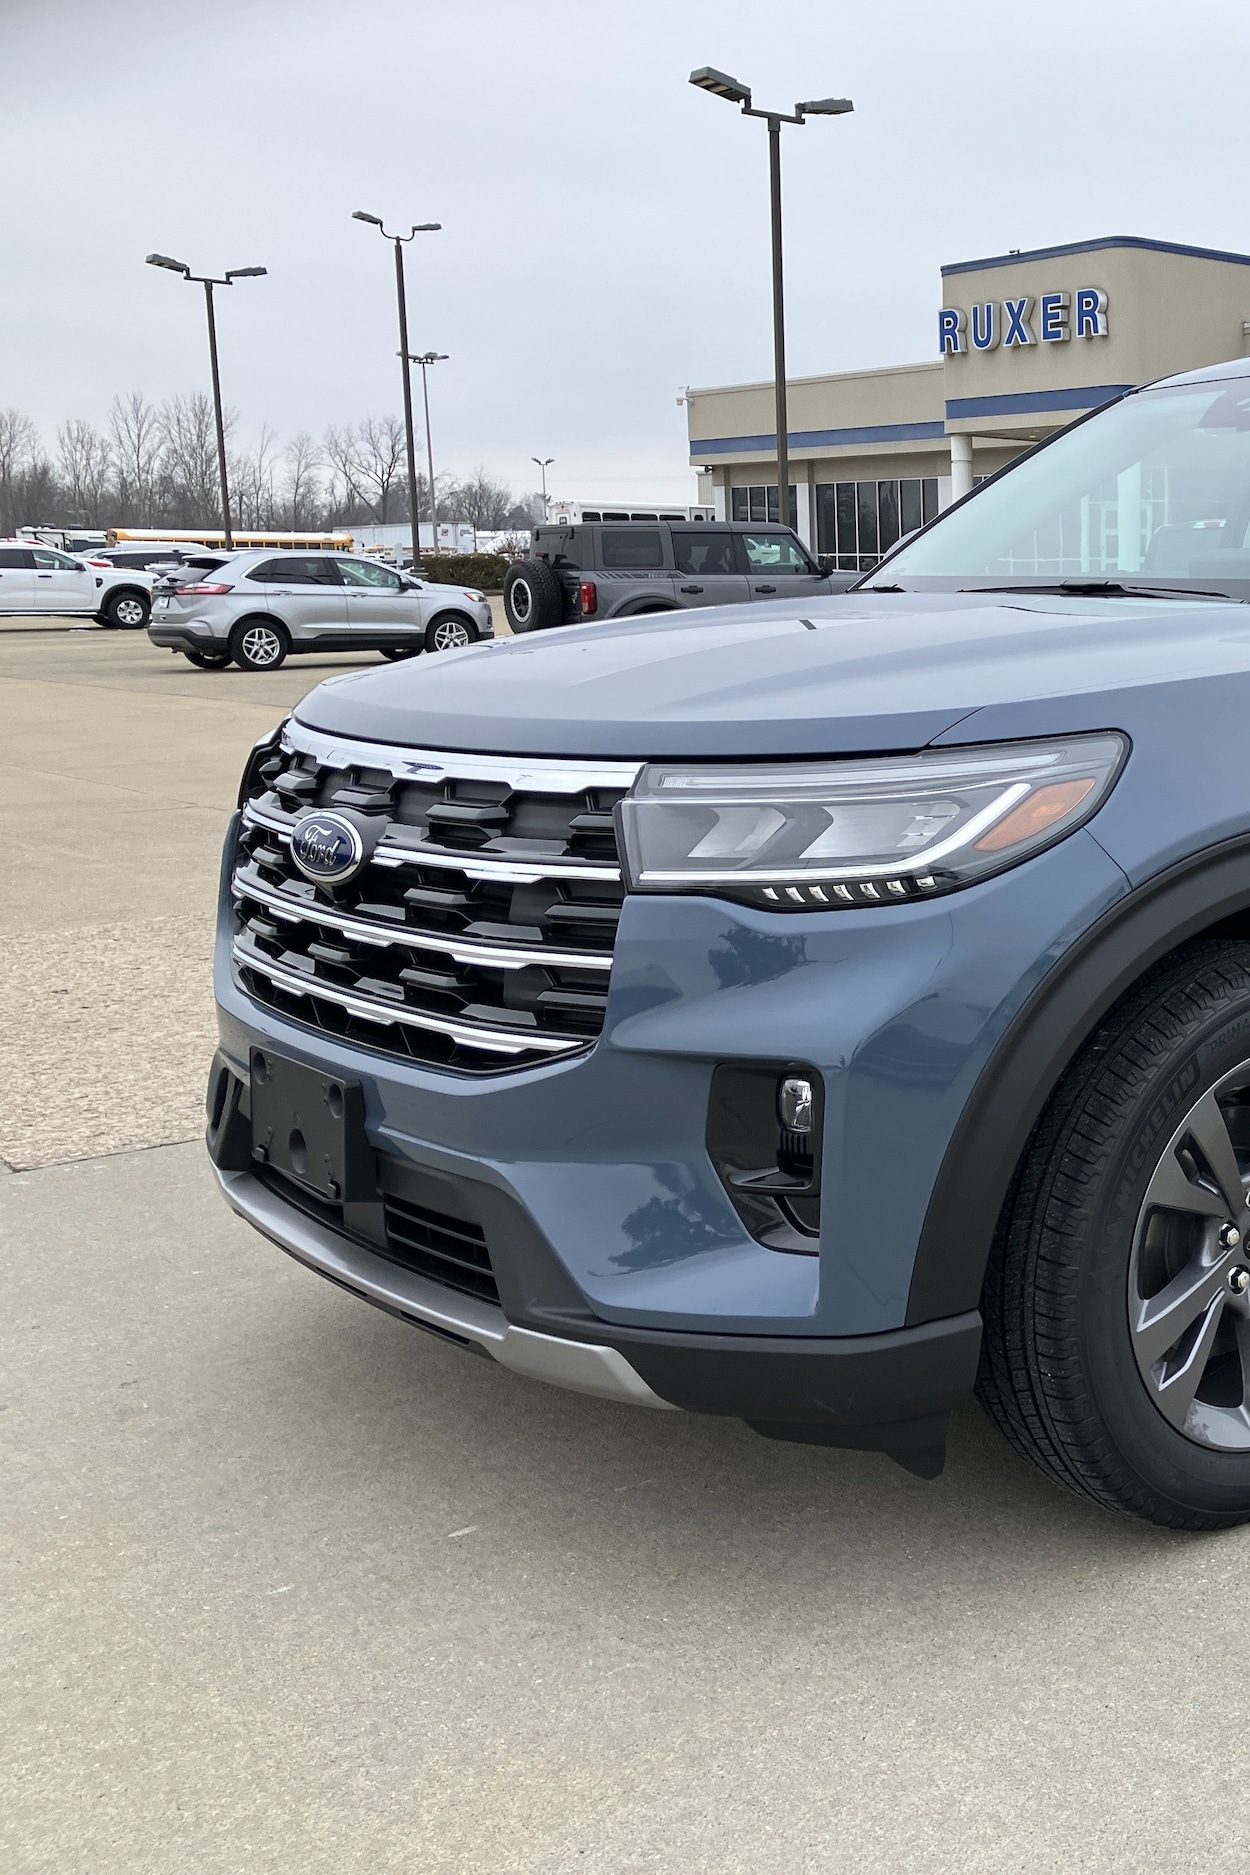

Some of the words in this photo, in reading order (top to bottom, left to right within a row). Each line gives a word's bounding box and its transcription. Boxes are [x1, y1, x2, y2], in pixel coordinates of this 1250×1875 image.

[938, 287, 1109, 355] RUXER
[299, 823, 341, 867] Ford
[1114, 1063, 1196, 1212] MICHELIN
